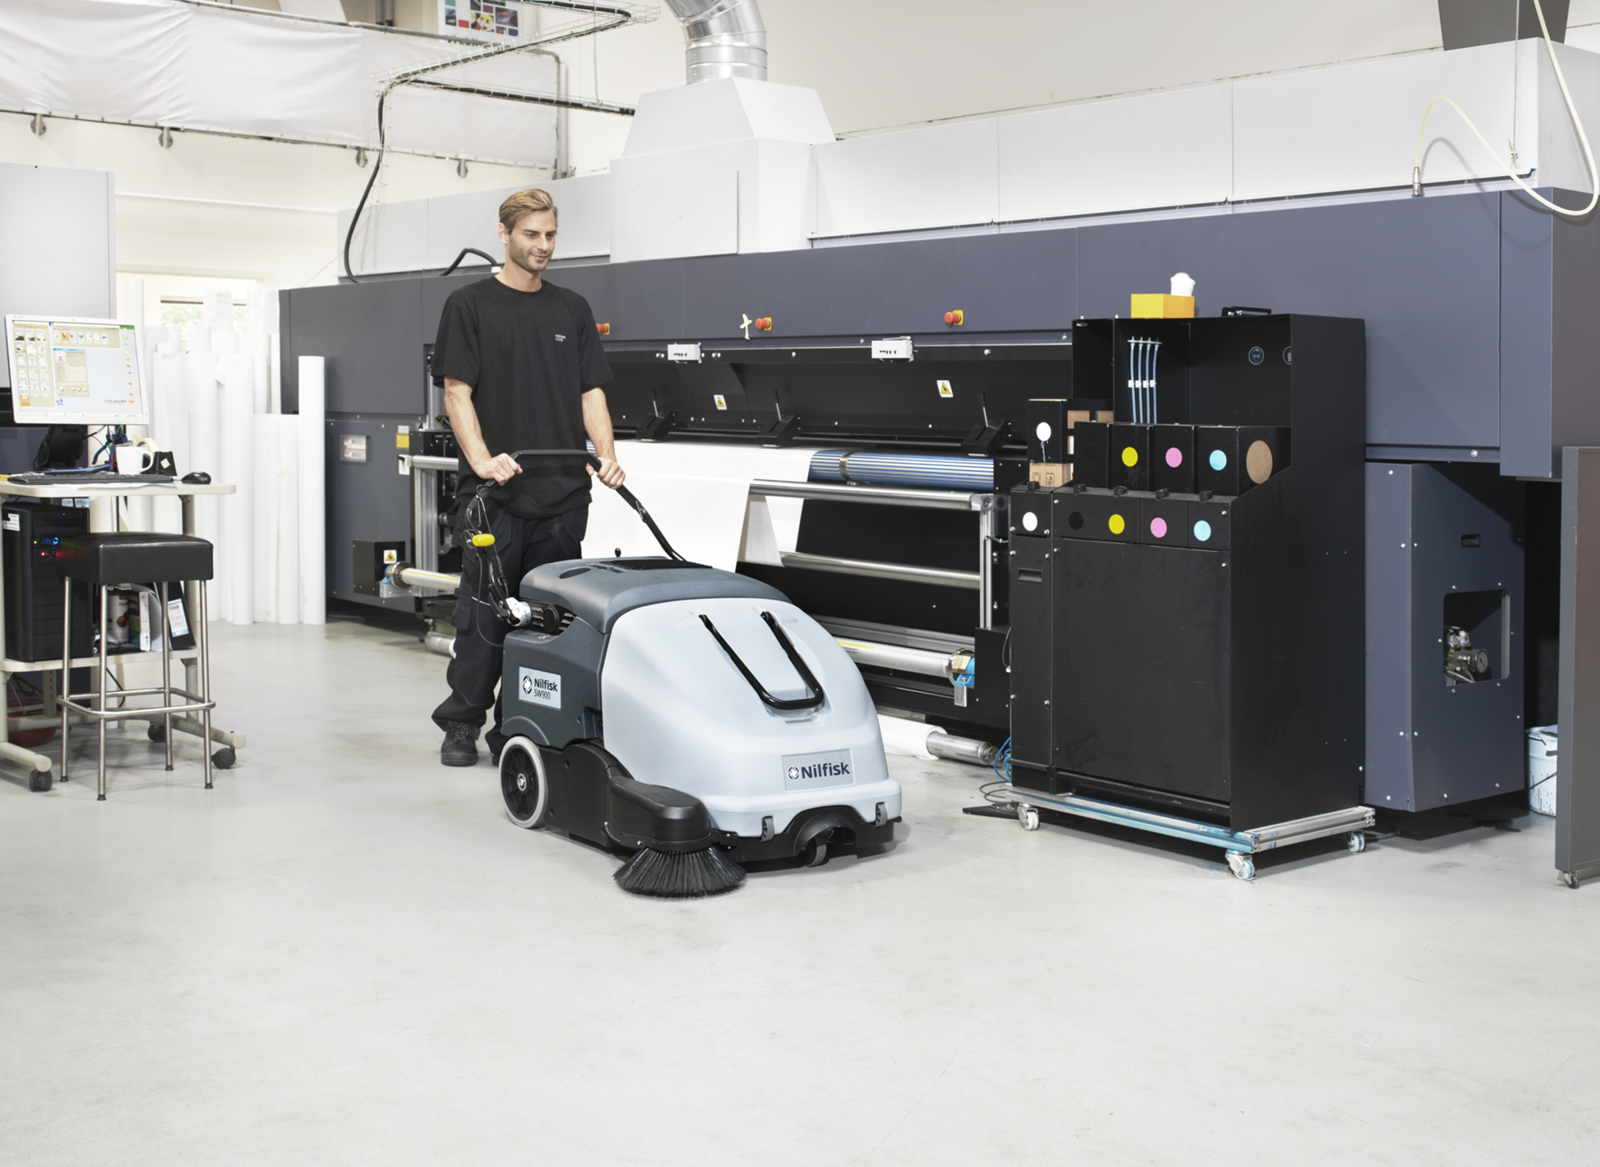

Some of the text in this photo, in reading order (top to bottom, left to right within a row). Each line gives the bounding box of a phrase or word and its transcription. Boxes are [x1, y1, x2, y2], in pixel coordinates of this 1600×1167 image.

[534, 678, 558, 692] Nilfisk
[534, 689, 551, 700] SW900
[801, 762, 850, 779] Nilfisk
